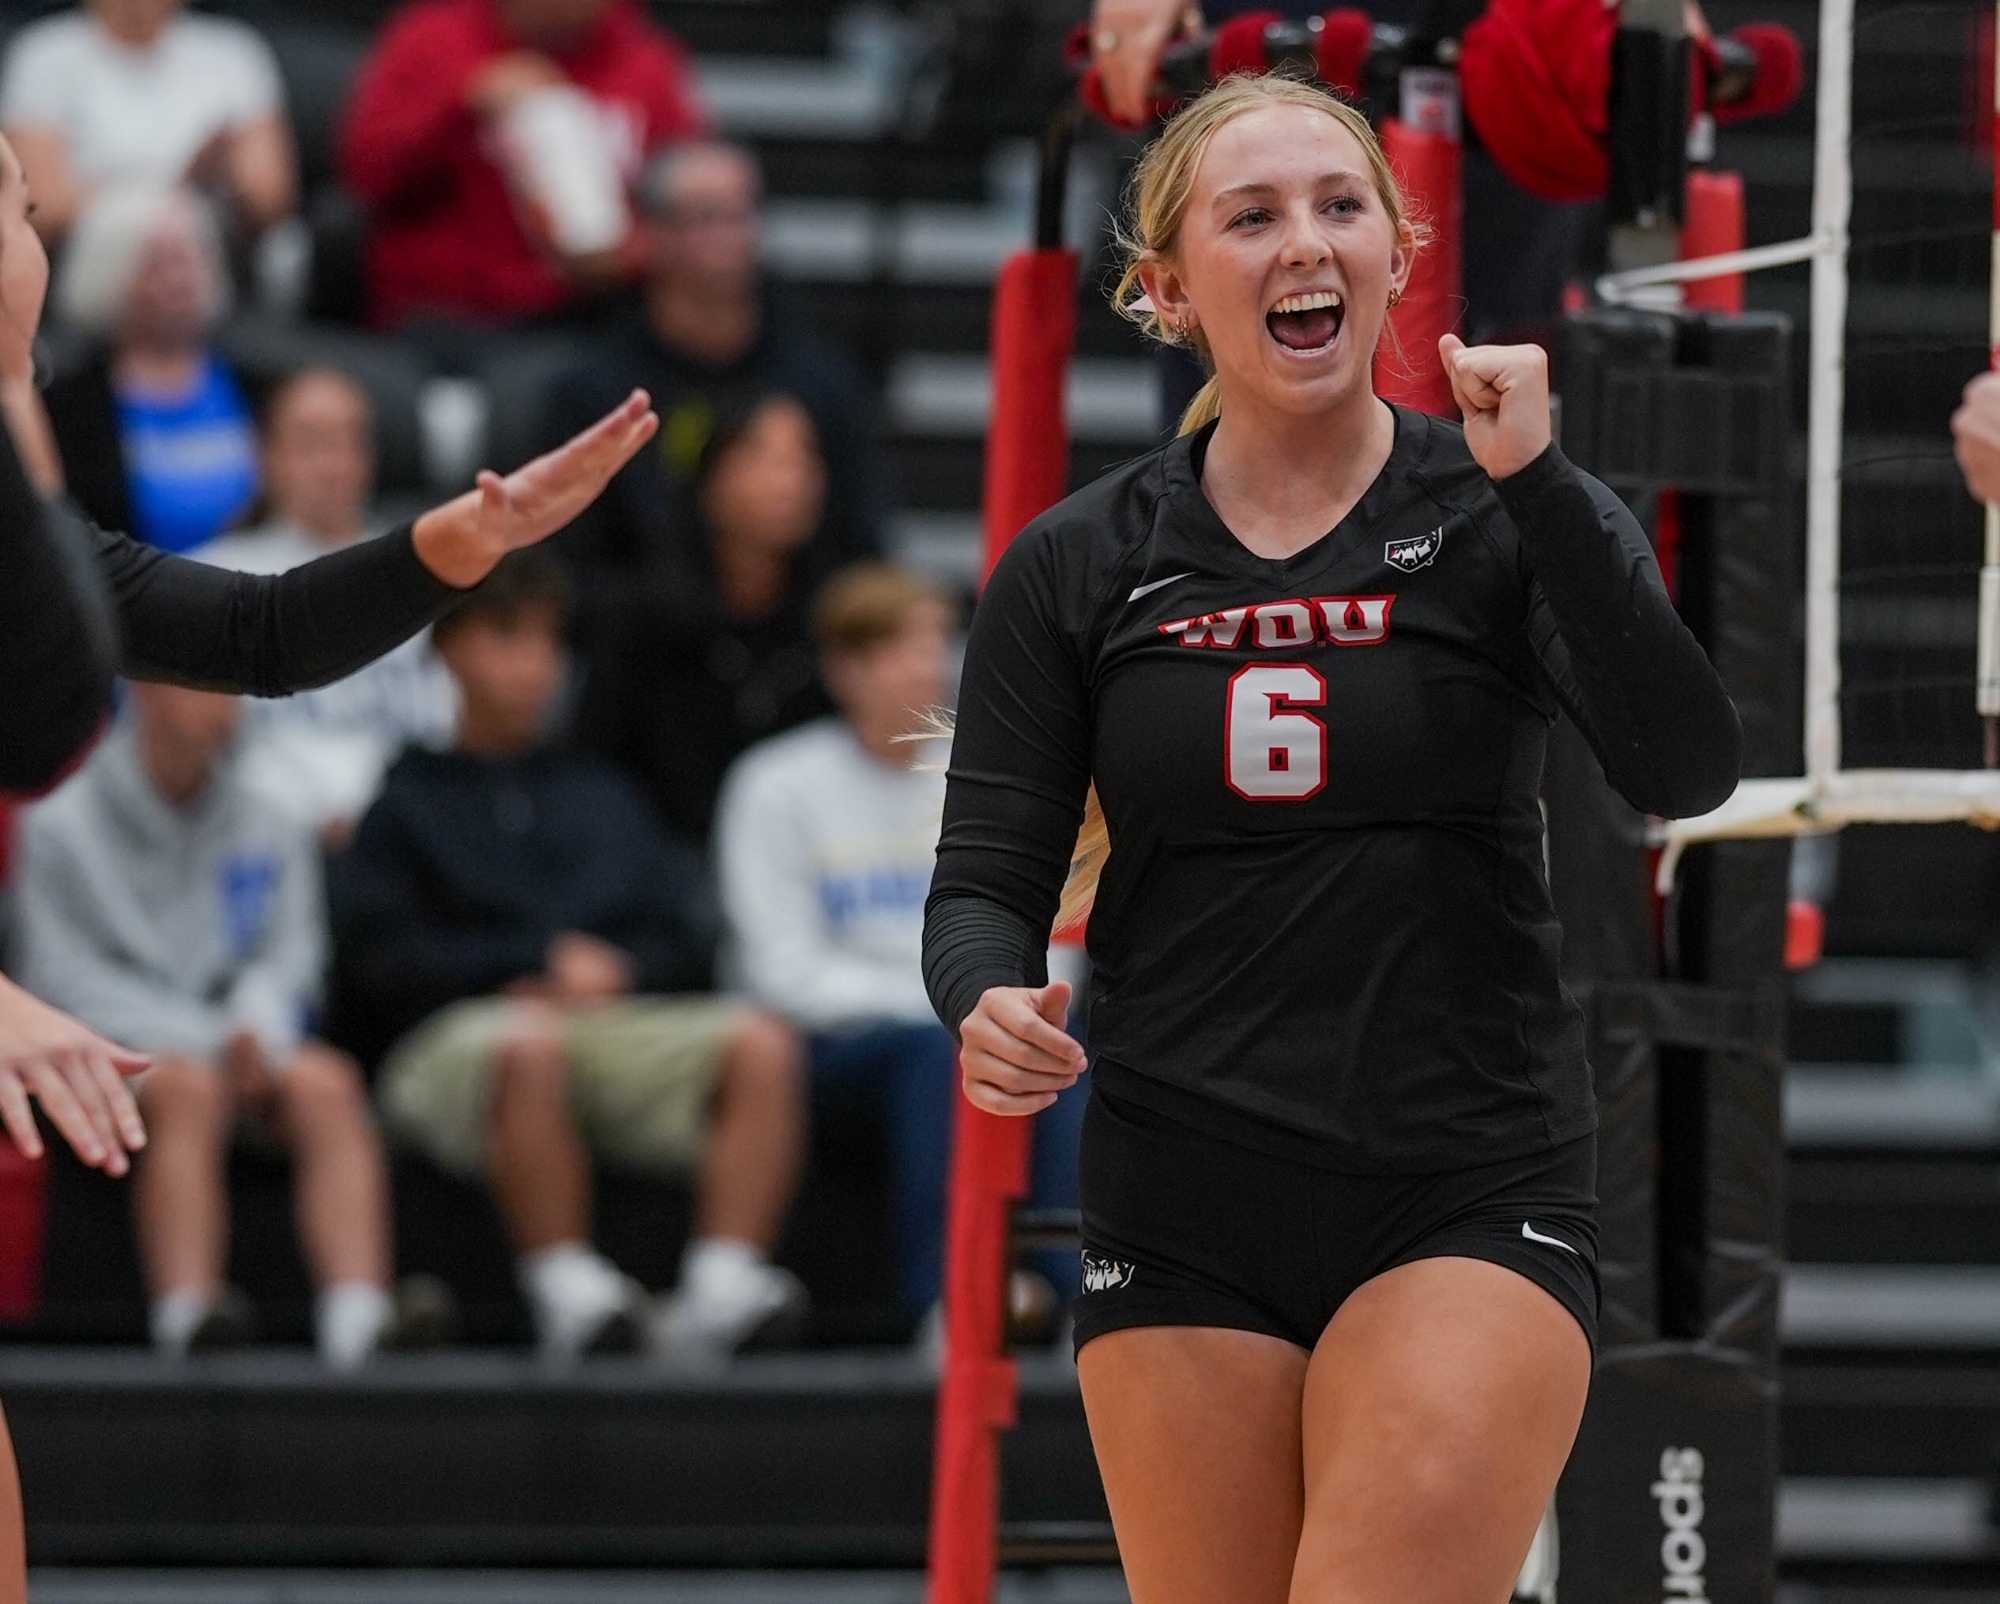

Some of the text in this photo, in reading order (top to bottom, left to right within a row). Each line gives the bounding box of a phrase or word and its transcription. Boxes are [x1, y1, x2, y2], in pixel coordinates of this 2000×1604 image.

[1157, 594, 1397, 648] WOU
[1223, 661, 1328, 801] 6
[1651, 1446, 1709, 1604] spor
